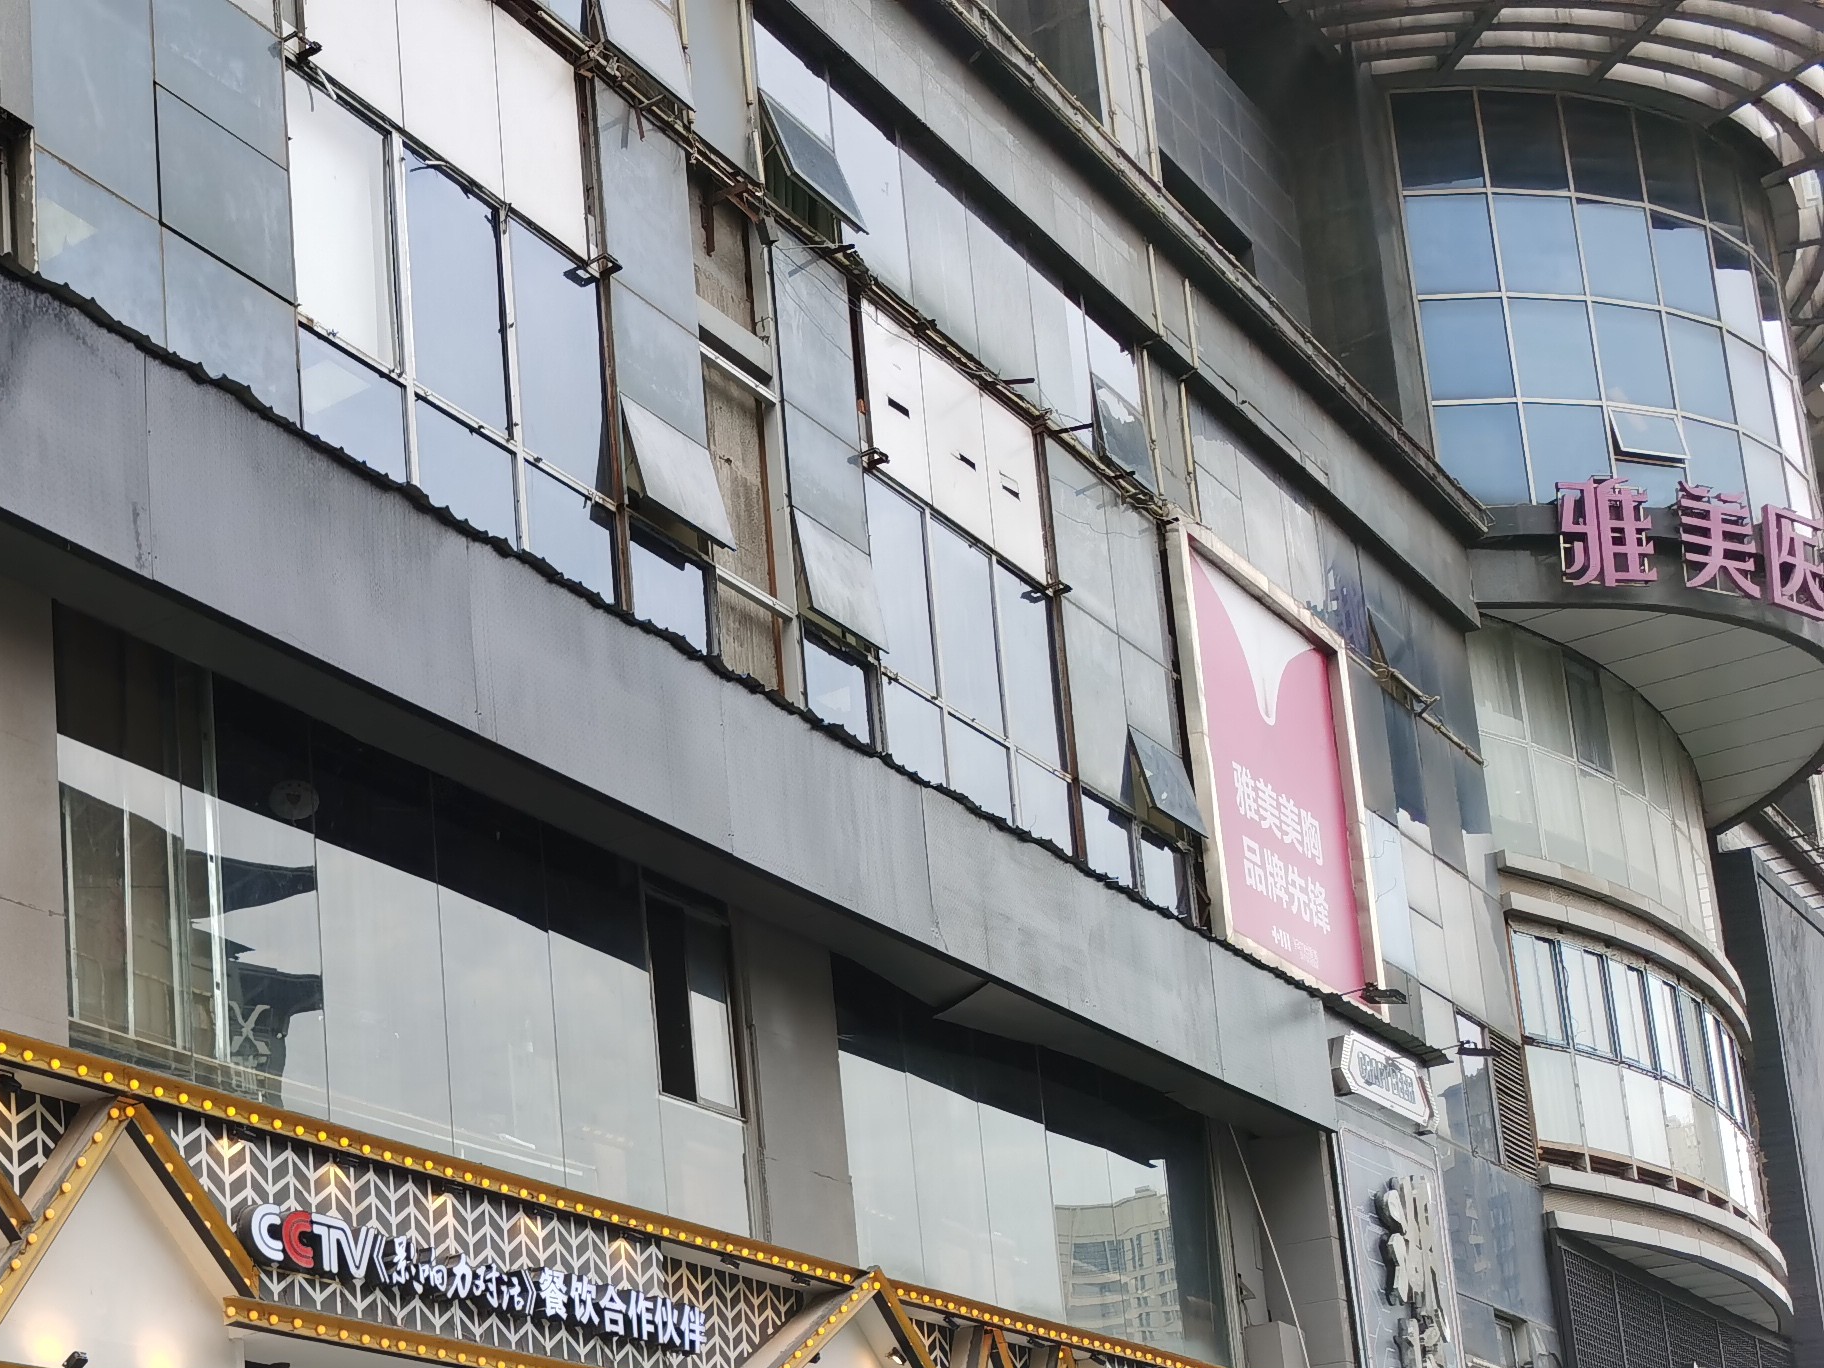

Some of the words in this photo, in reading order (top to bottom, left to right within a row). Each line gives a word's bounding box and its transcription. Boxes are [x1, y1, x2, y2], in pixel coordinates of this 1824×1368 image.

[1232, 761, 1323, 866] 雅美美胸
[1242, 834, 1331, 935] 品牌先锋
